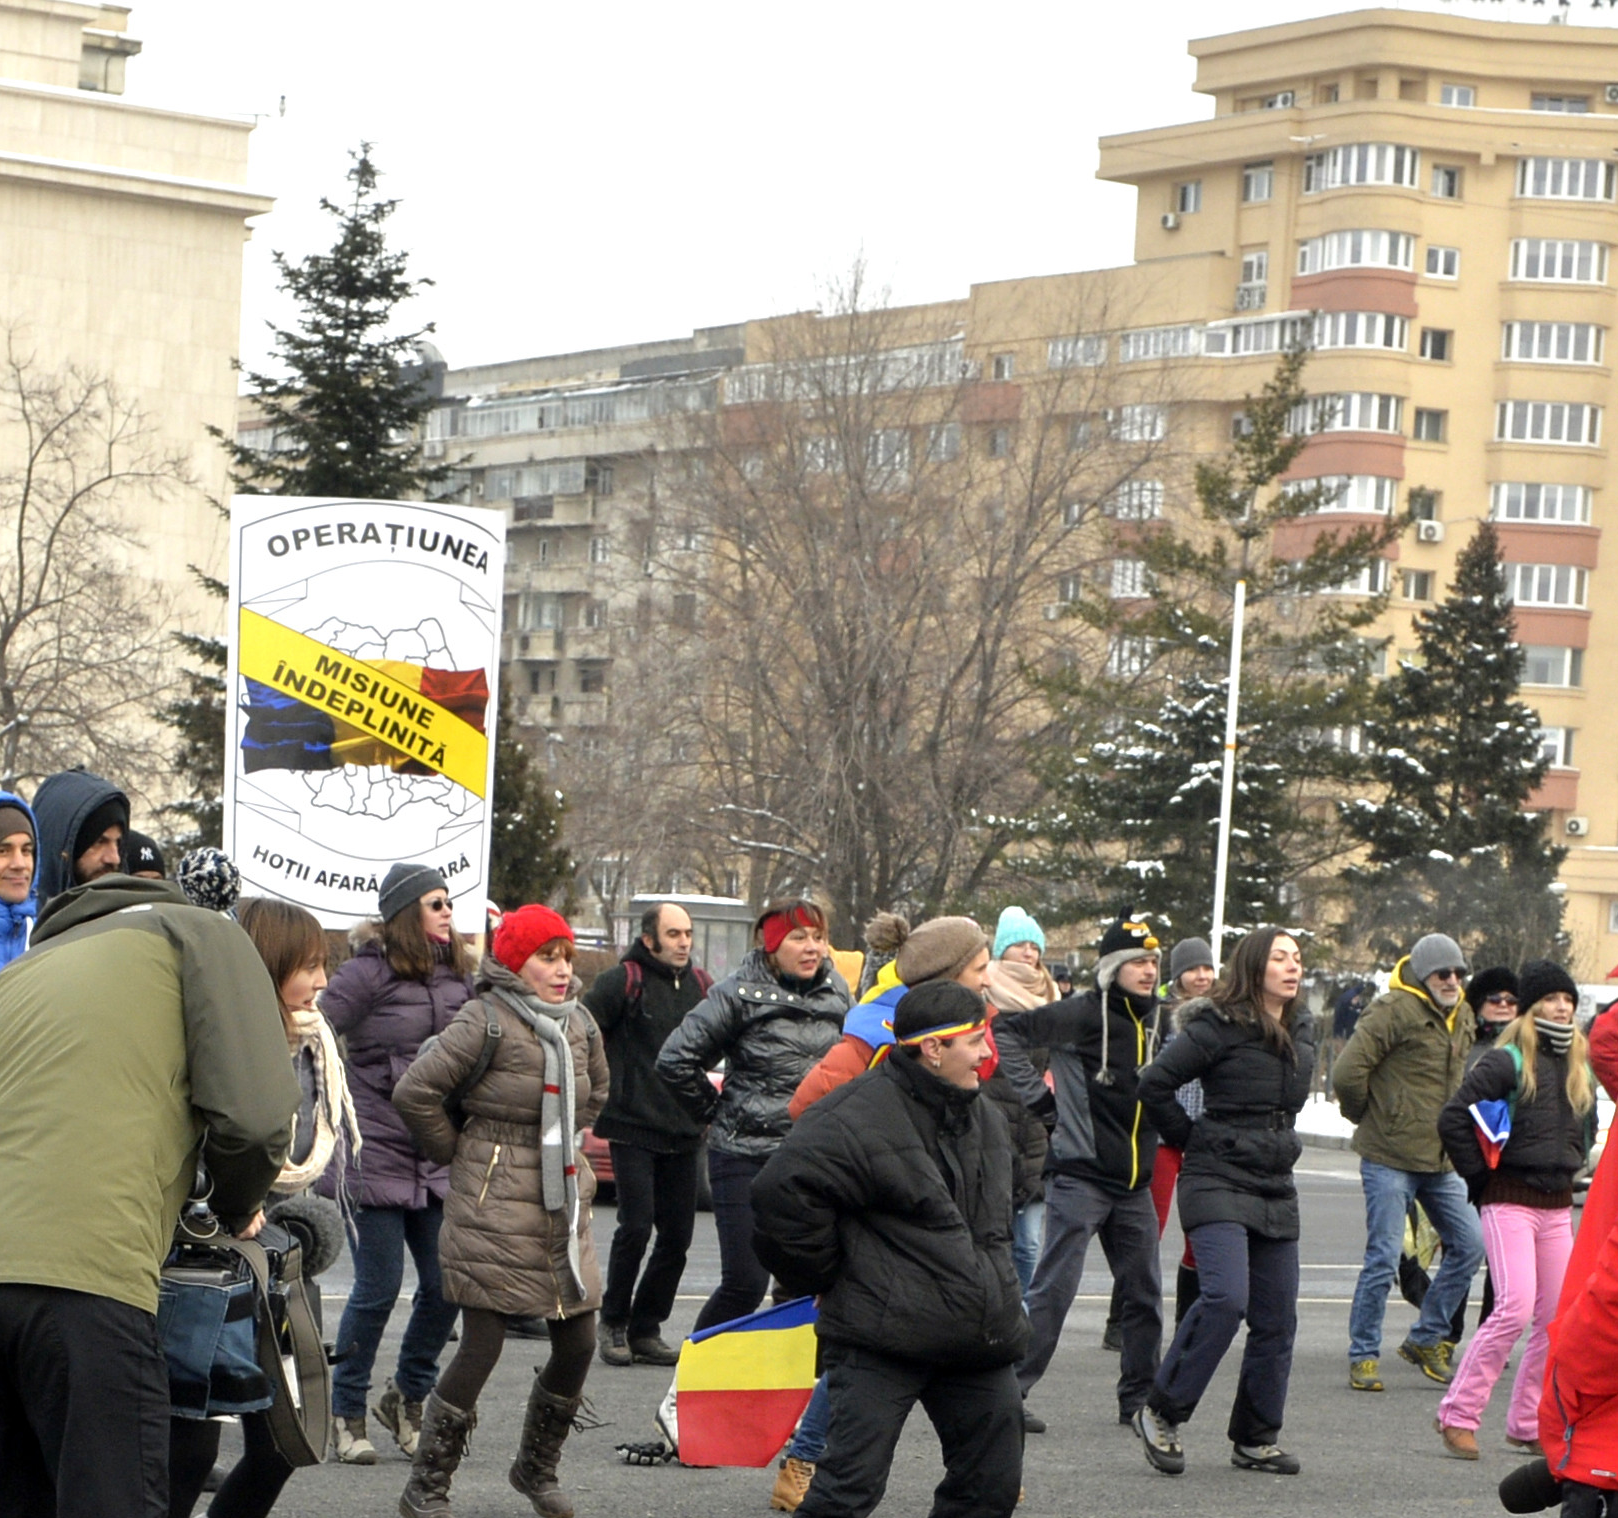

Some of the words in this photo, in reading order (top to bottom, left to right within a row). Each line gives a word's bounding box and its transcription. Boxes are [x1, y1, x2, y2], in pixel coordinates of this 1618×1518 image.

[267, 522, 489, 575] OPERAȚIUNEA
[272, 660, 448, 768] ÎNDEPLINITĂ
[315, 654, 435, 730] MISIUNE
[252, 845, 309, 883] HOȚII
[314, 868, 379, 893] AFARĂ
[438, 851, 471, 880] ARĂ
